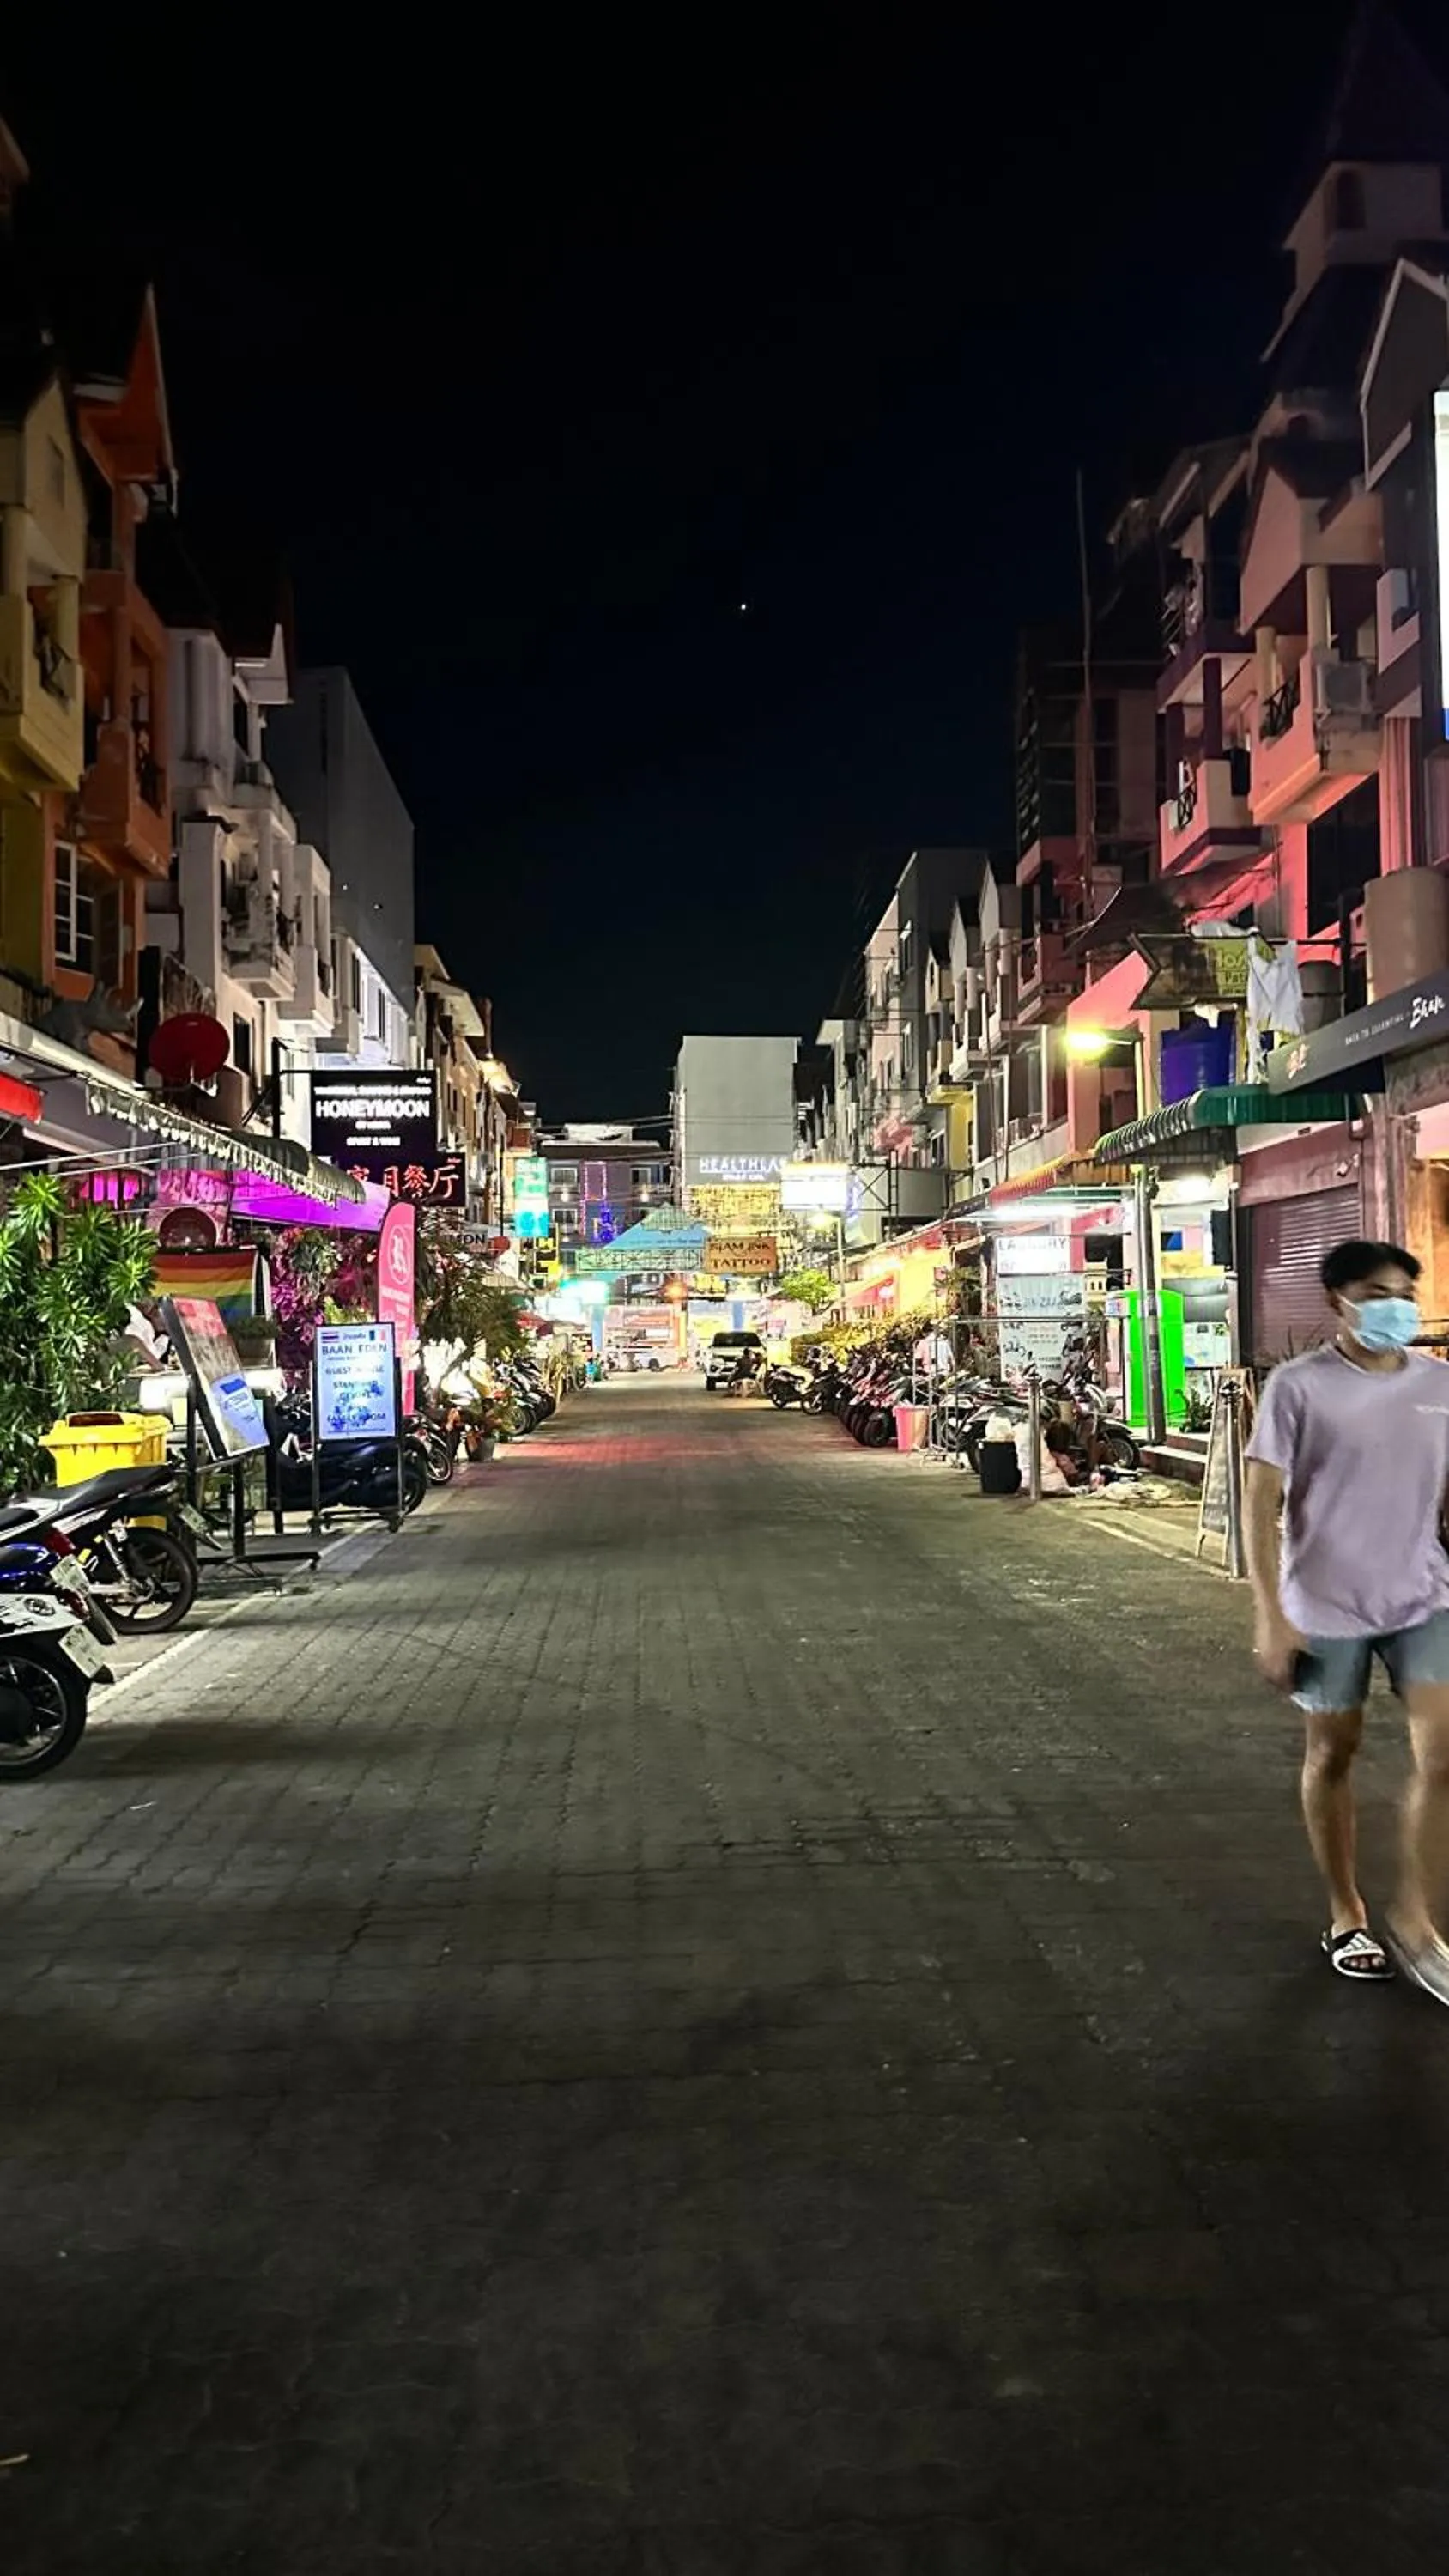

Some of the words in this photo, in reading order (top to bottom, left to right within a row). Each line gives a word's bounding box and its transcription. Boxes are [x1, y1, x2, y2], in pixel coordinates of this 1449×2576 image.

[315, 1100, 430, 1118] HONEYMOON
[699, 1158, 786, 1173] HEALTHLA
[709, 1242, 743, 1254] SIAM
[711, 1257, 772, 1268] TATTOO
[322, 1346, 353, 1355] BAAN
